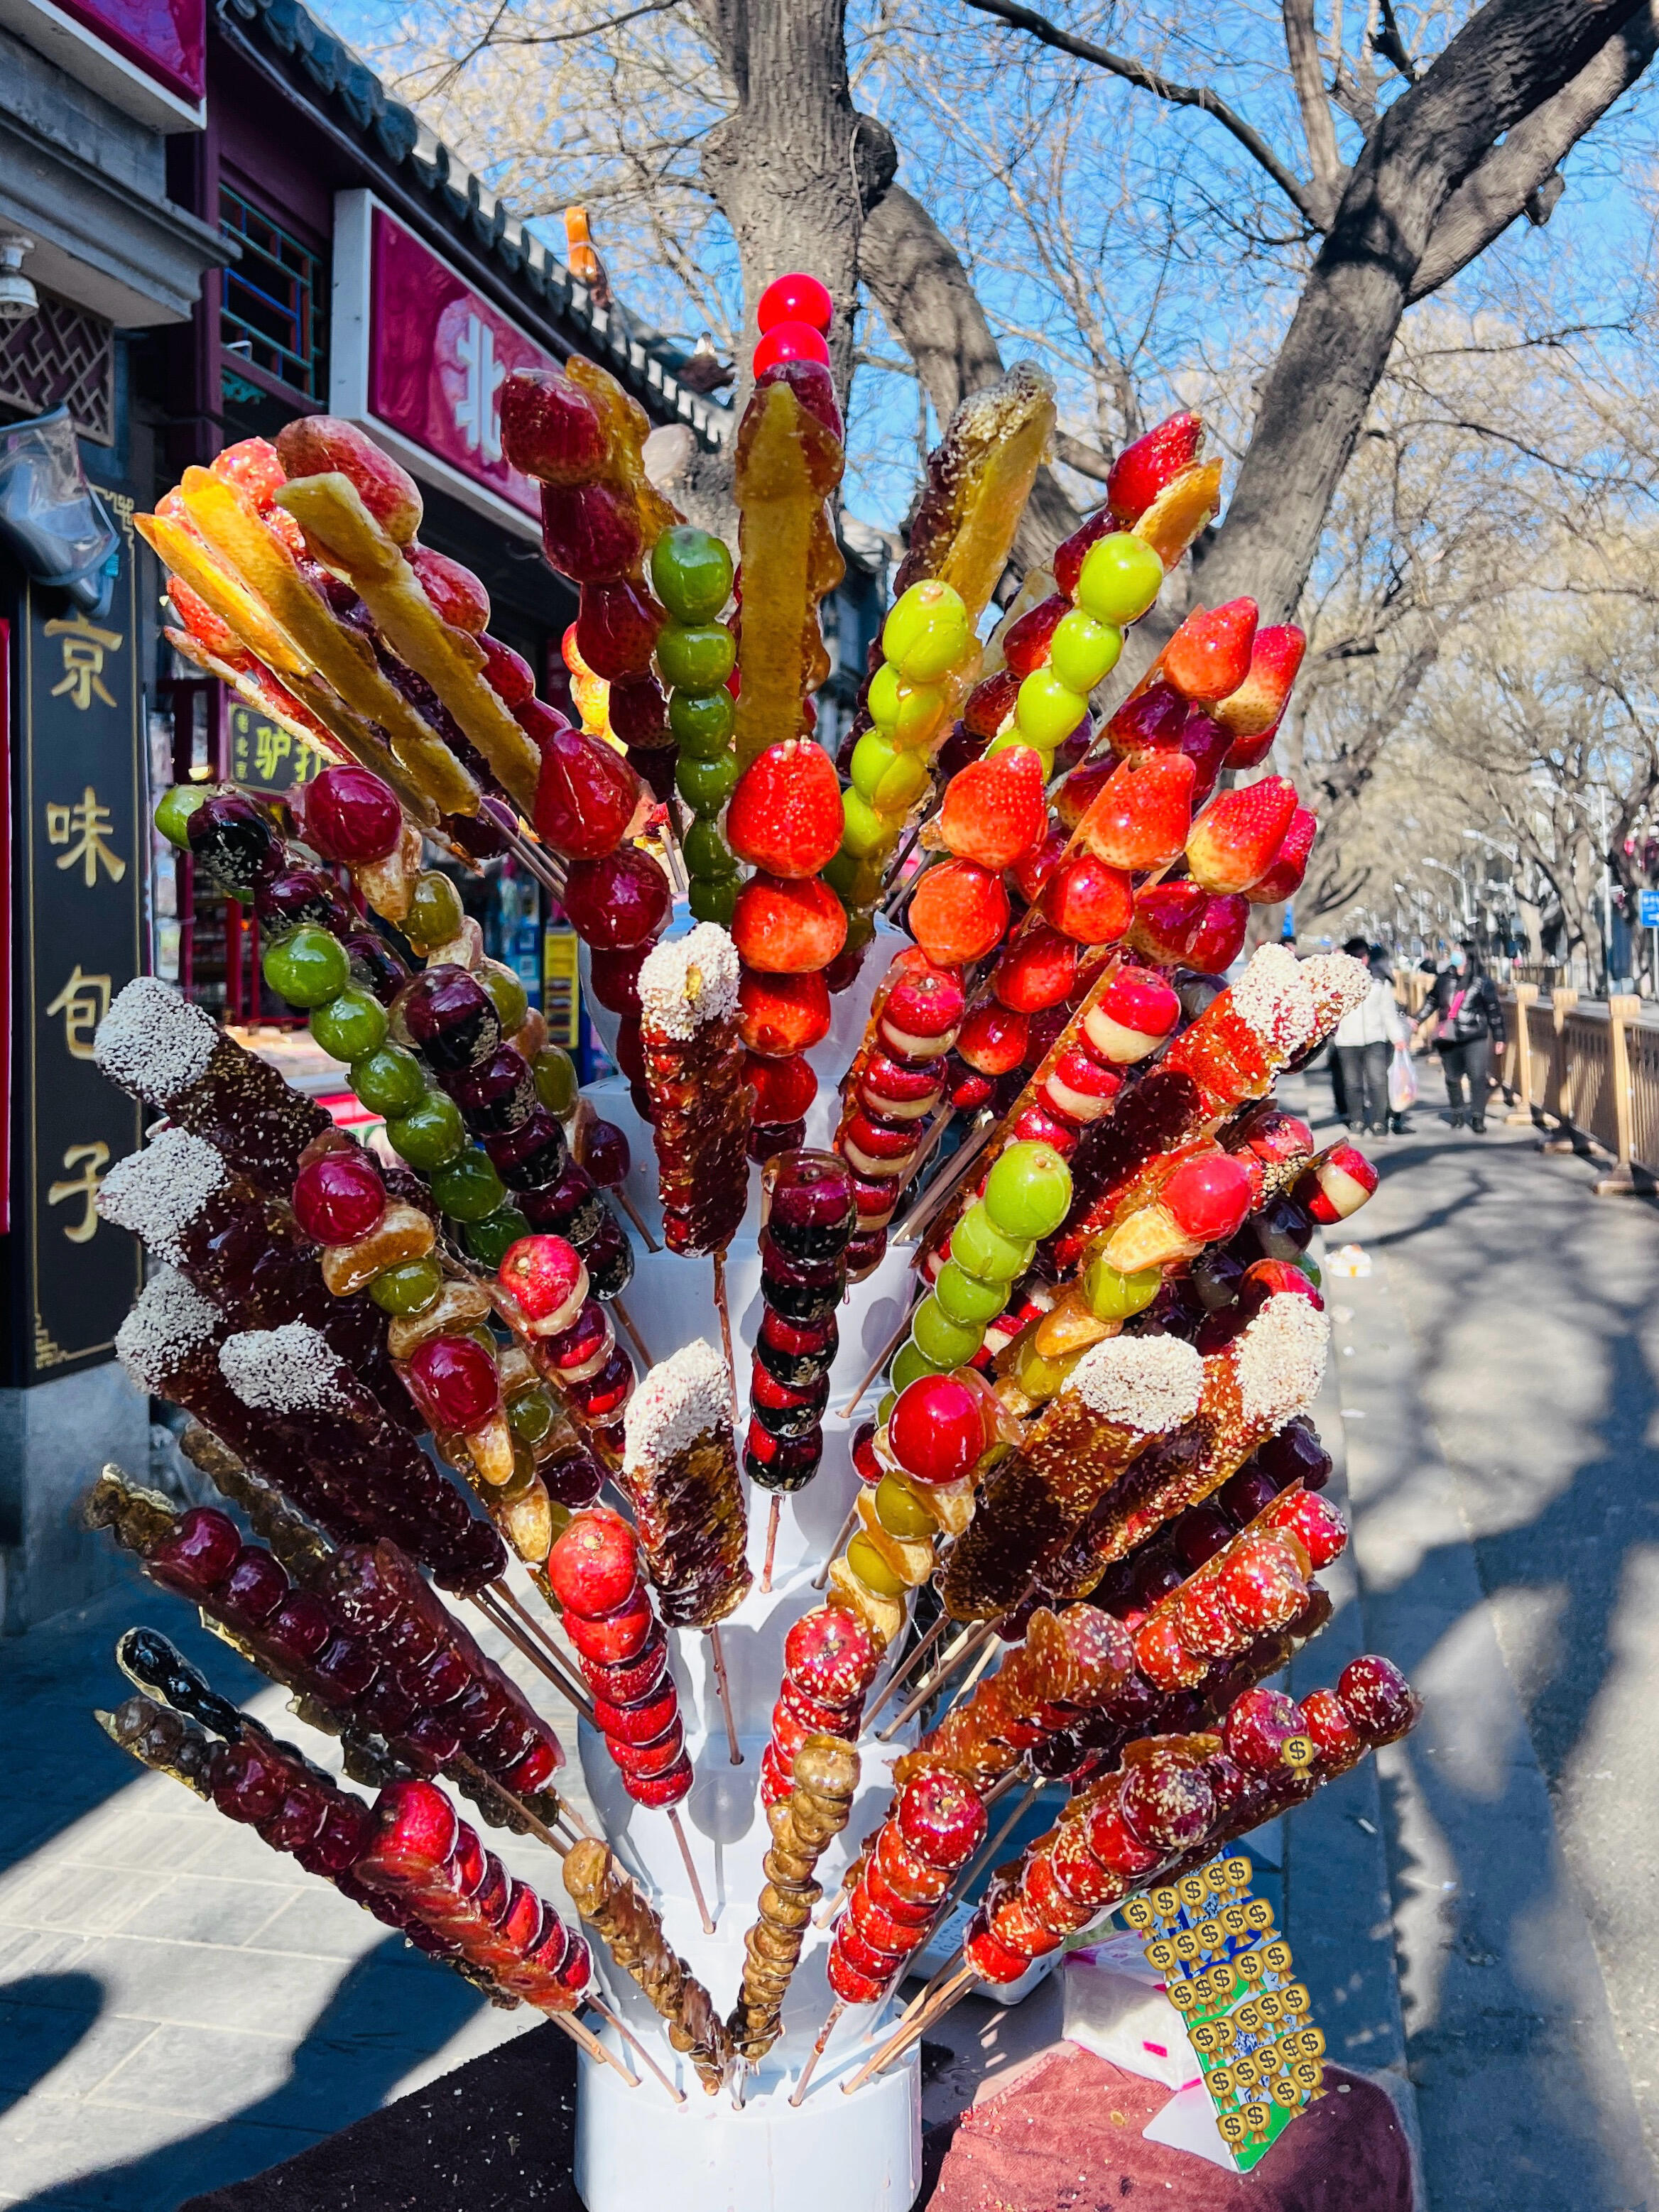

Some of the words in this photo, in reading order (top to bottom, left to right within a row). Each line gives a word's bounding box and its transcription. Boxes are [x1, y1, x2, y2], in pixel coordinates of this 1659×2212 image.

[457, 312, 506, 465] 北
[44, 611, 126, 1243] 京味包子
